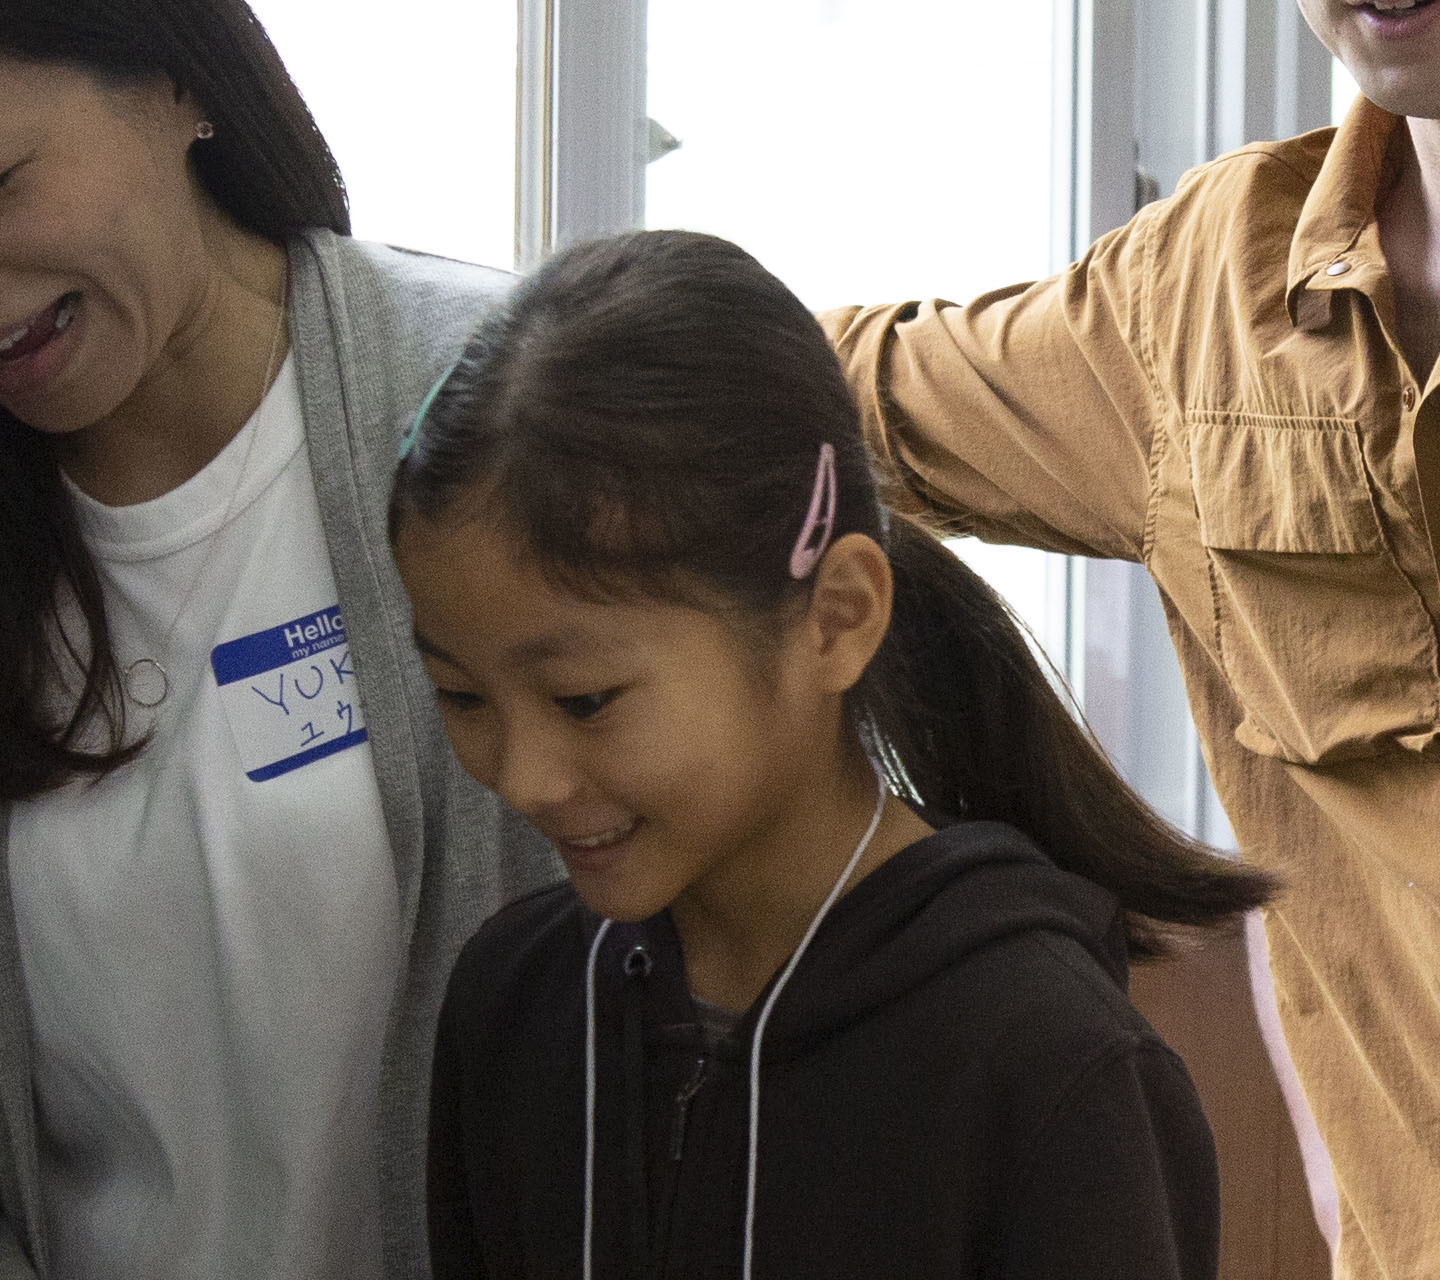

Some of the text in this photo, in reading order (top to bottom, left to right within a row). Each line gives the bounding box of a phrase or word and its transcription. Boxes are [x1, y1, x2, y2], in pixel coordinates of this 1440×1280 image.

[284, 613, 344, 648] Hello
[292, 646, 310, 660] my
[251, 650, 354, 716] YUK
